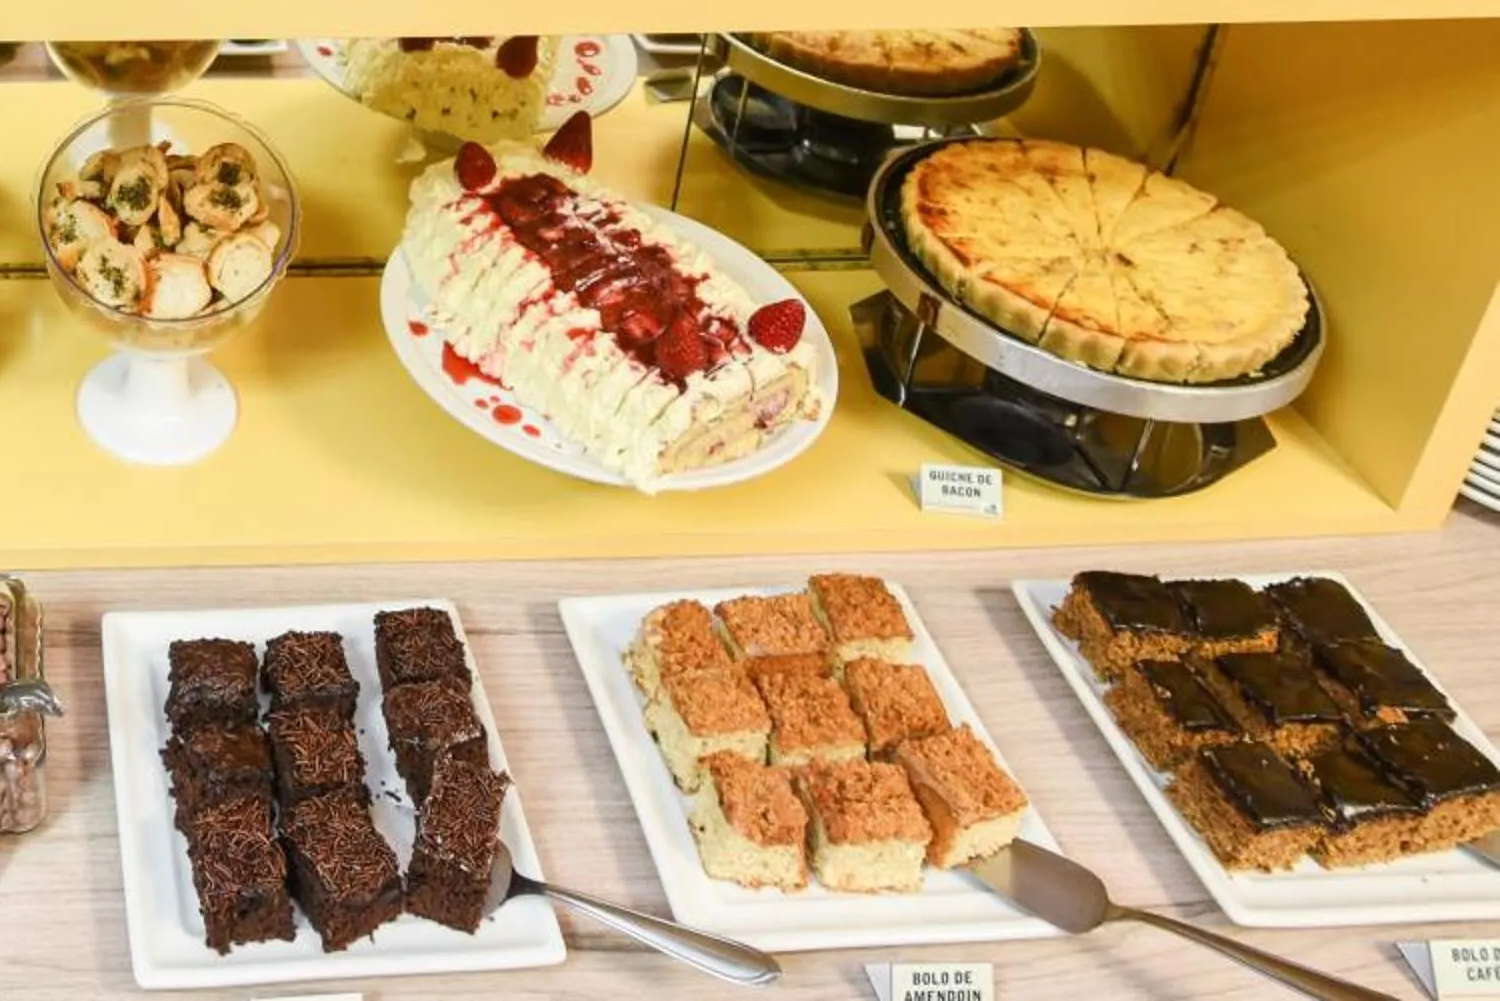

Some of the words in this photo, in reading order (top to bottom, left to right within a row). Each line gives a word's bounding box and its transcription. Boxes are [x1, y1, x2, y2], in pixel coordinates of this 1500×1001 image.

[977, 474, 993, 486] DE
[941, 484, 981, 497] BACON
[1452, 947, 1489, 962] BOLO
[912, 971, 949, 986] BOLO
[954, 970, 973, 984] DE
